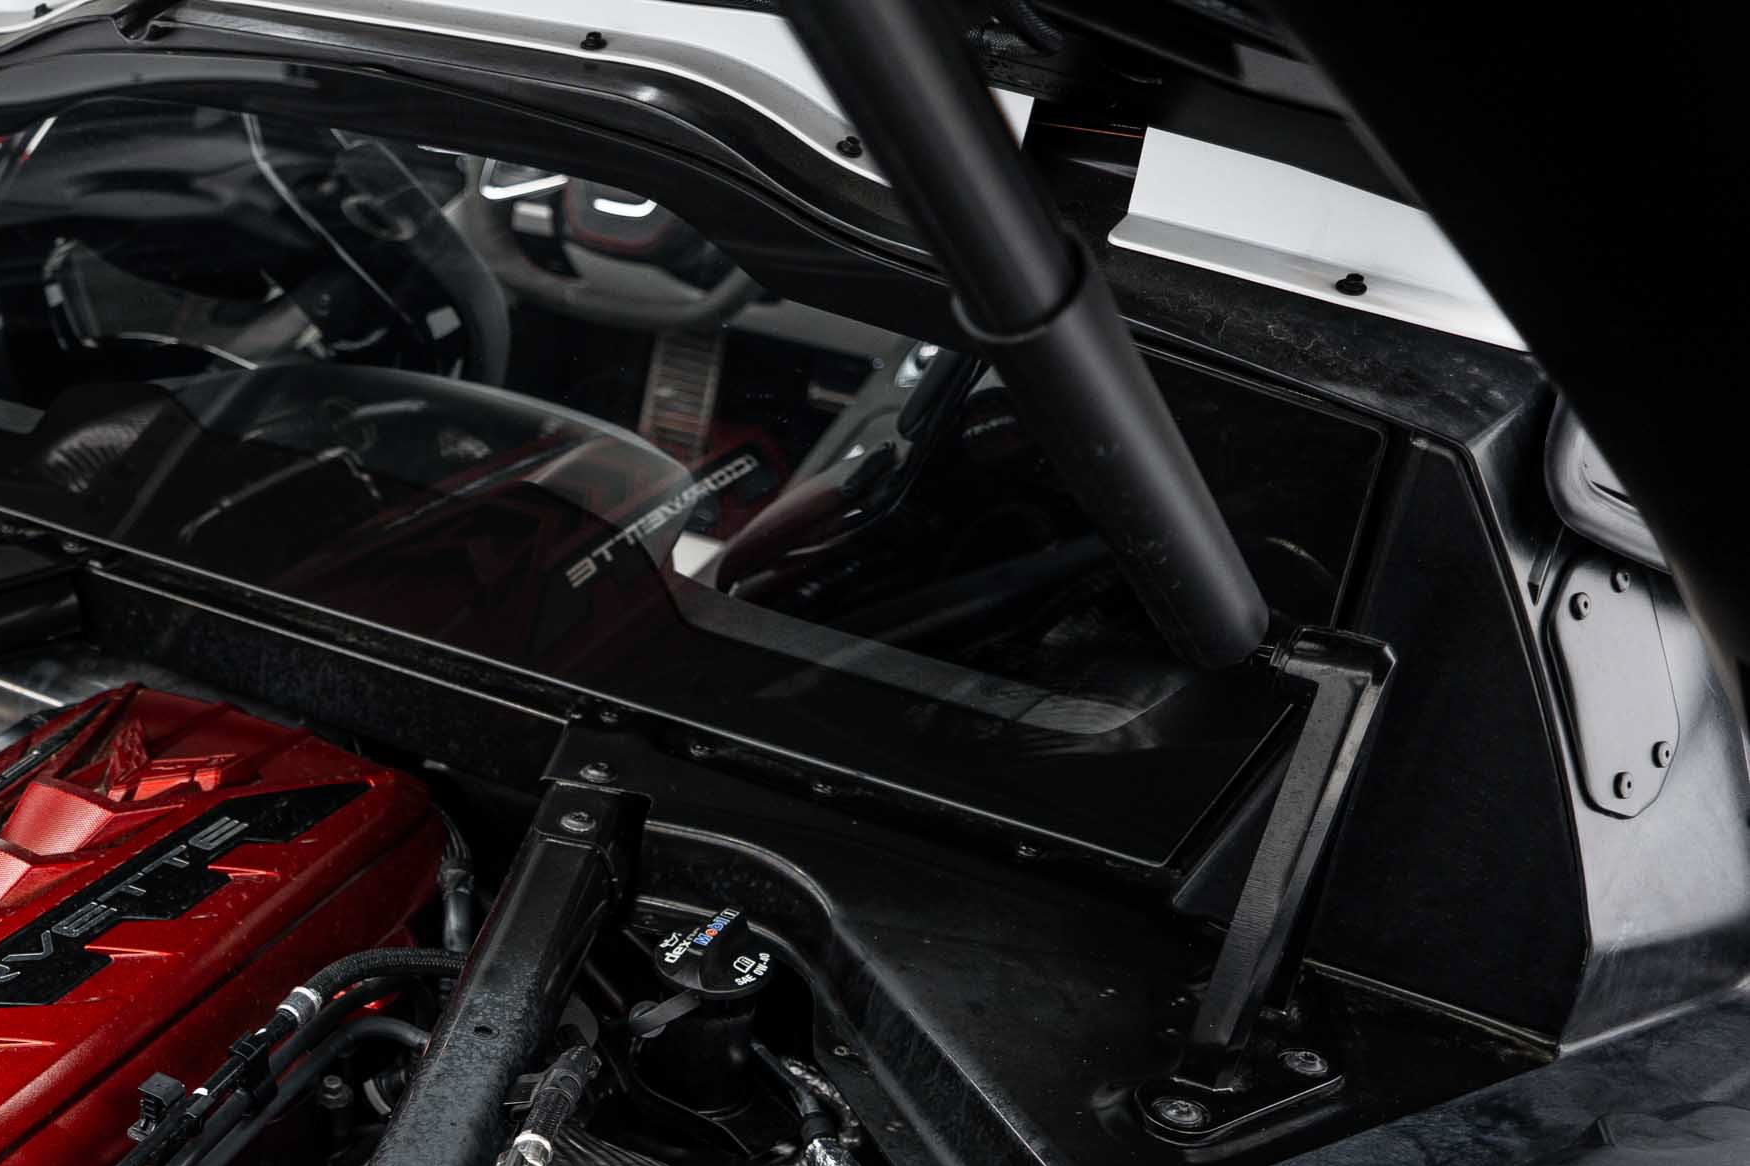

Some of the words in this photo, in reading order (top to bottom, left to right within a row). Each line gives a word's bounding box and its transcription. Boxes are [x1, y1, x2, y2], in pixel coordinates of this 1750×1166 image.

[693, 916, 730, 946] Mobil
[735, 974, 757, 986] SAE
[753, 952, 770, 976] 0W-40
